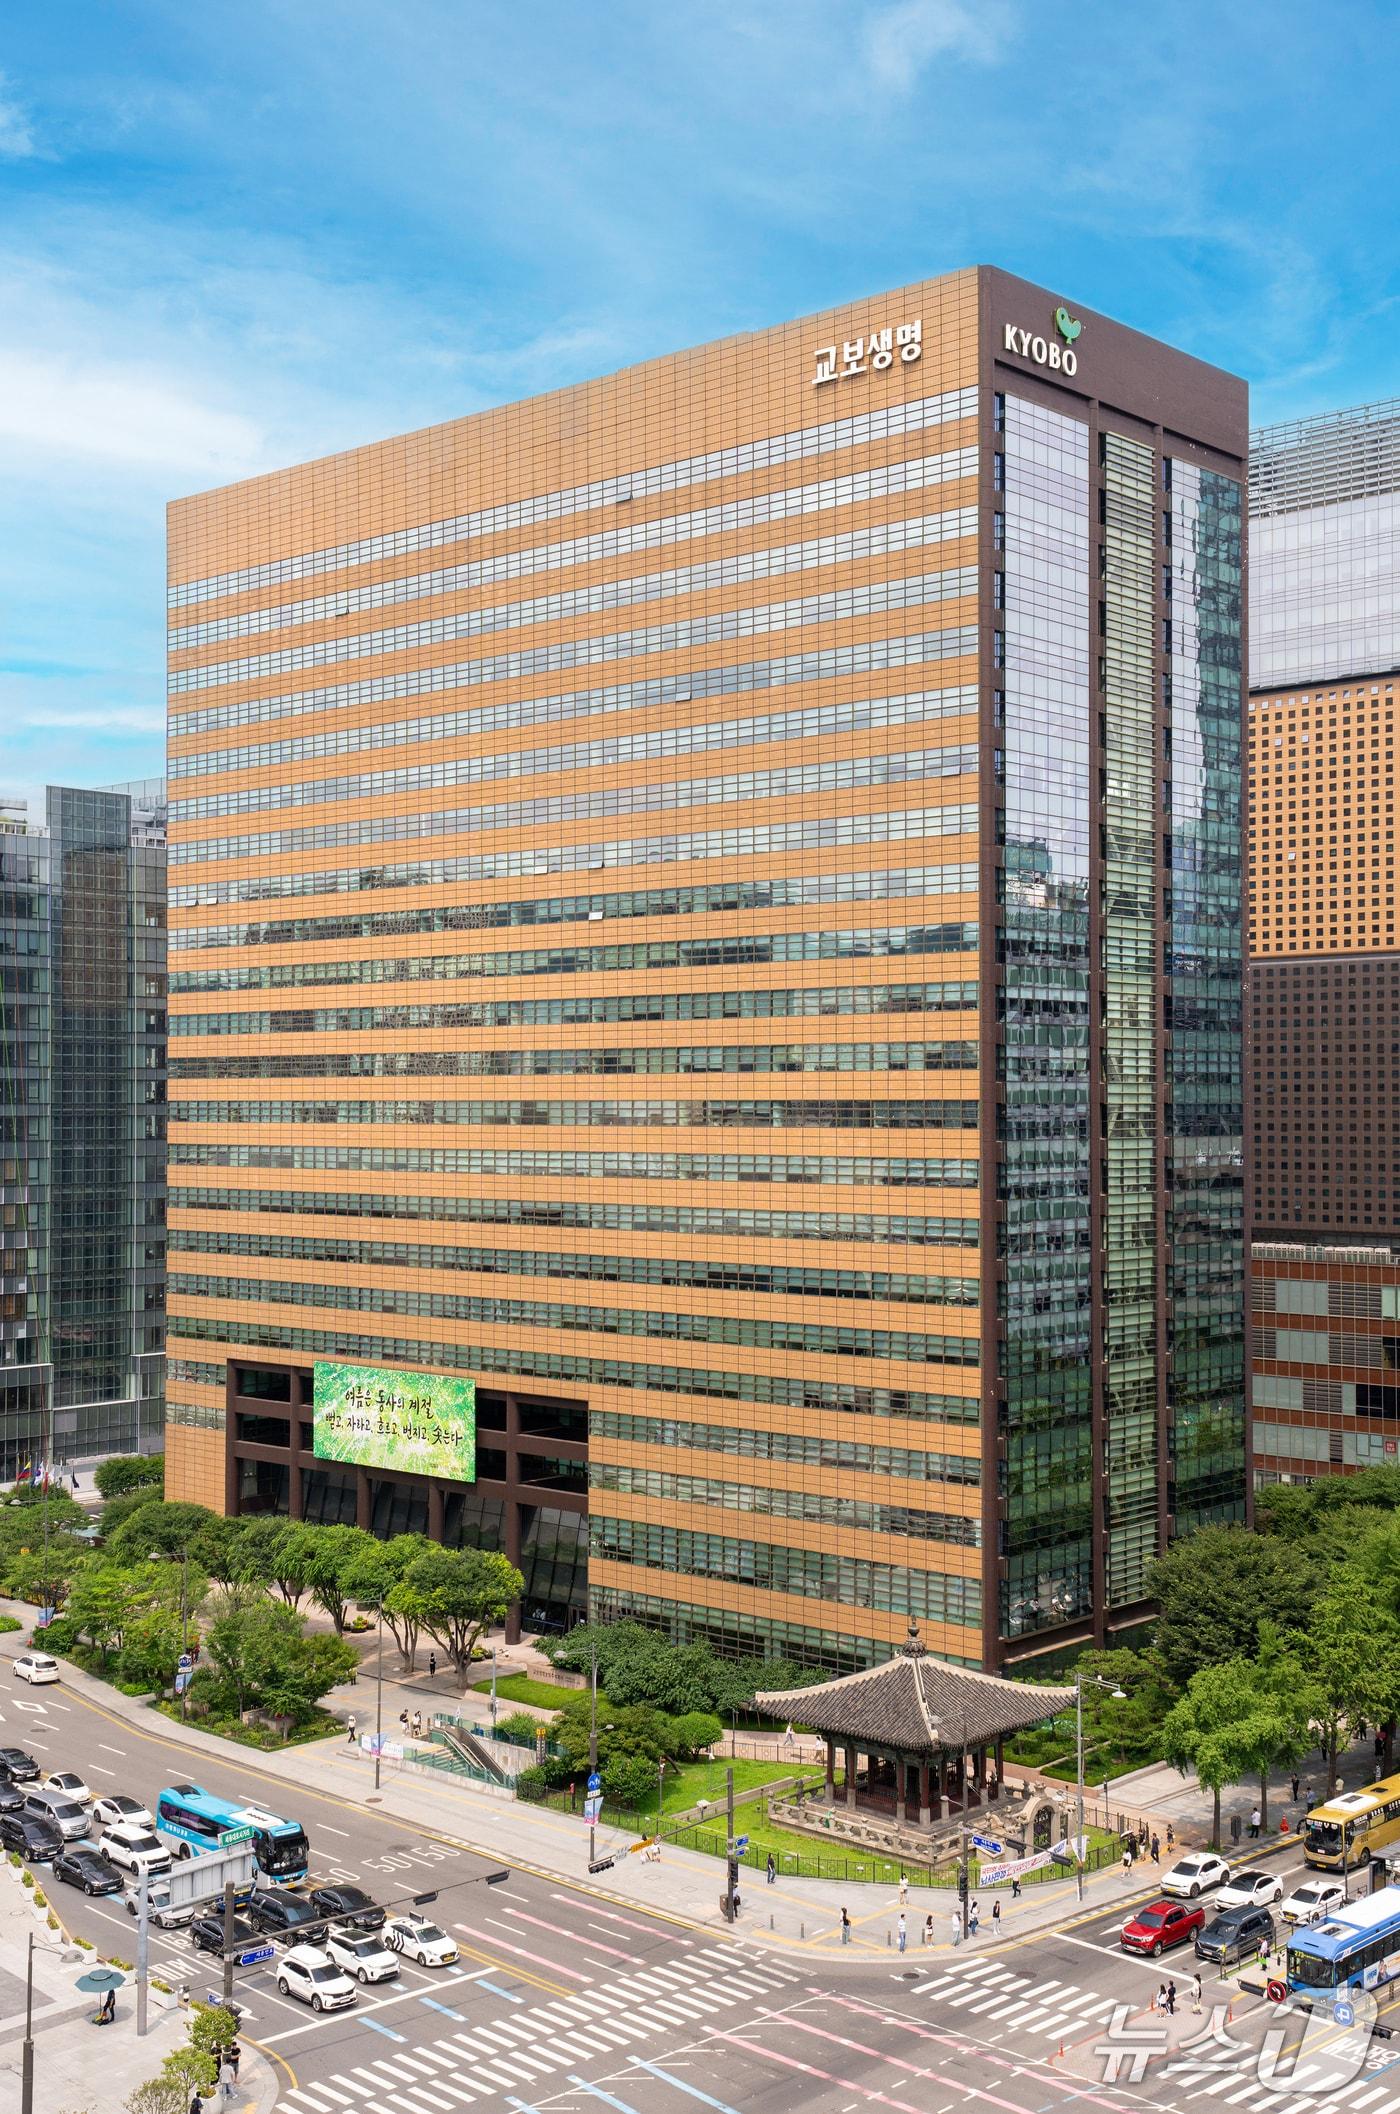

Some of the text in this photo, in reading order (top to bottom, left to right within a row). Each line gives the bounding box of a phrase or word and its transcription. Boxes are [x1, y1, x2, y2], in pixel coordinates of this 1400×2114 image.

[811, 319, 922, 385] 교보생명
[1004, 323, 1078, 377] KYOBO
[345, 1385, 434, 1420] 여름은 동사의 계절
[347, 1417, 374, 1433] 자라고,
[376, 1417, 400, 1437] 흐르고,
[402, 1423, 430, 1441] 번지고,
[431, 1425, 463, 1447] 솟는다
[360, 1855, 413, 1873] 50
[410, 1844, 461, 1861] 50
